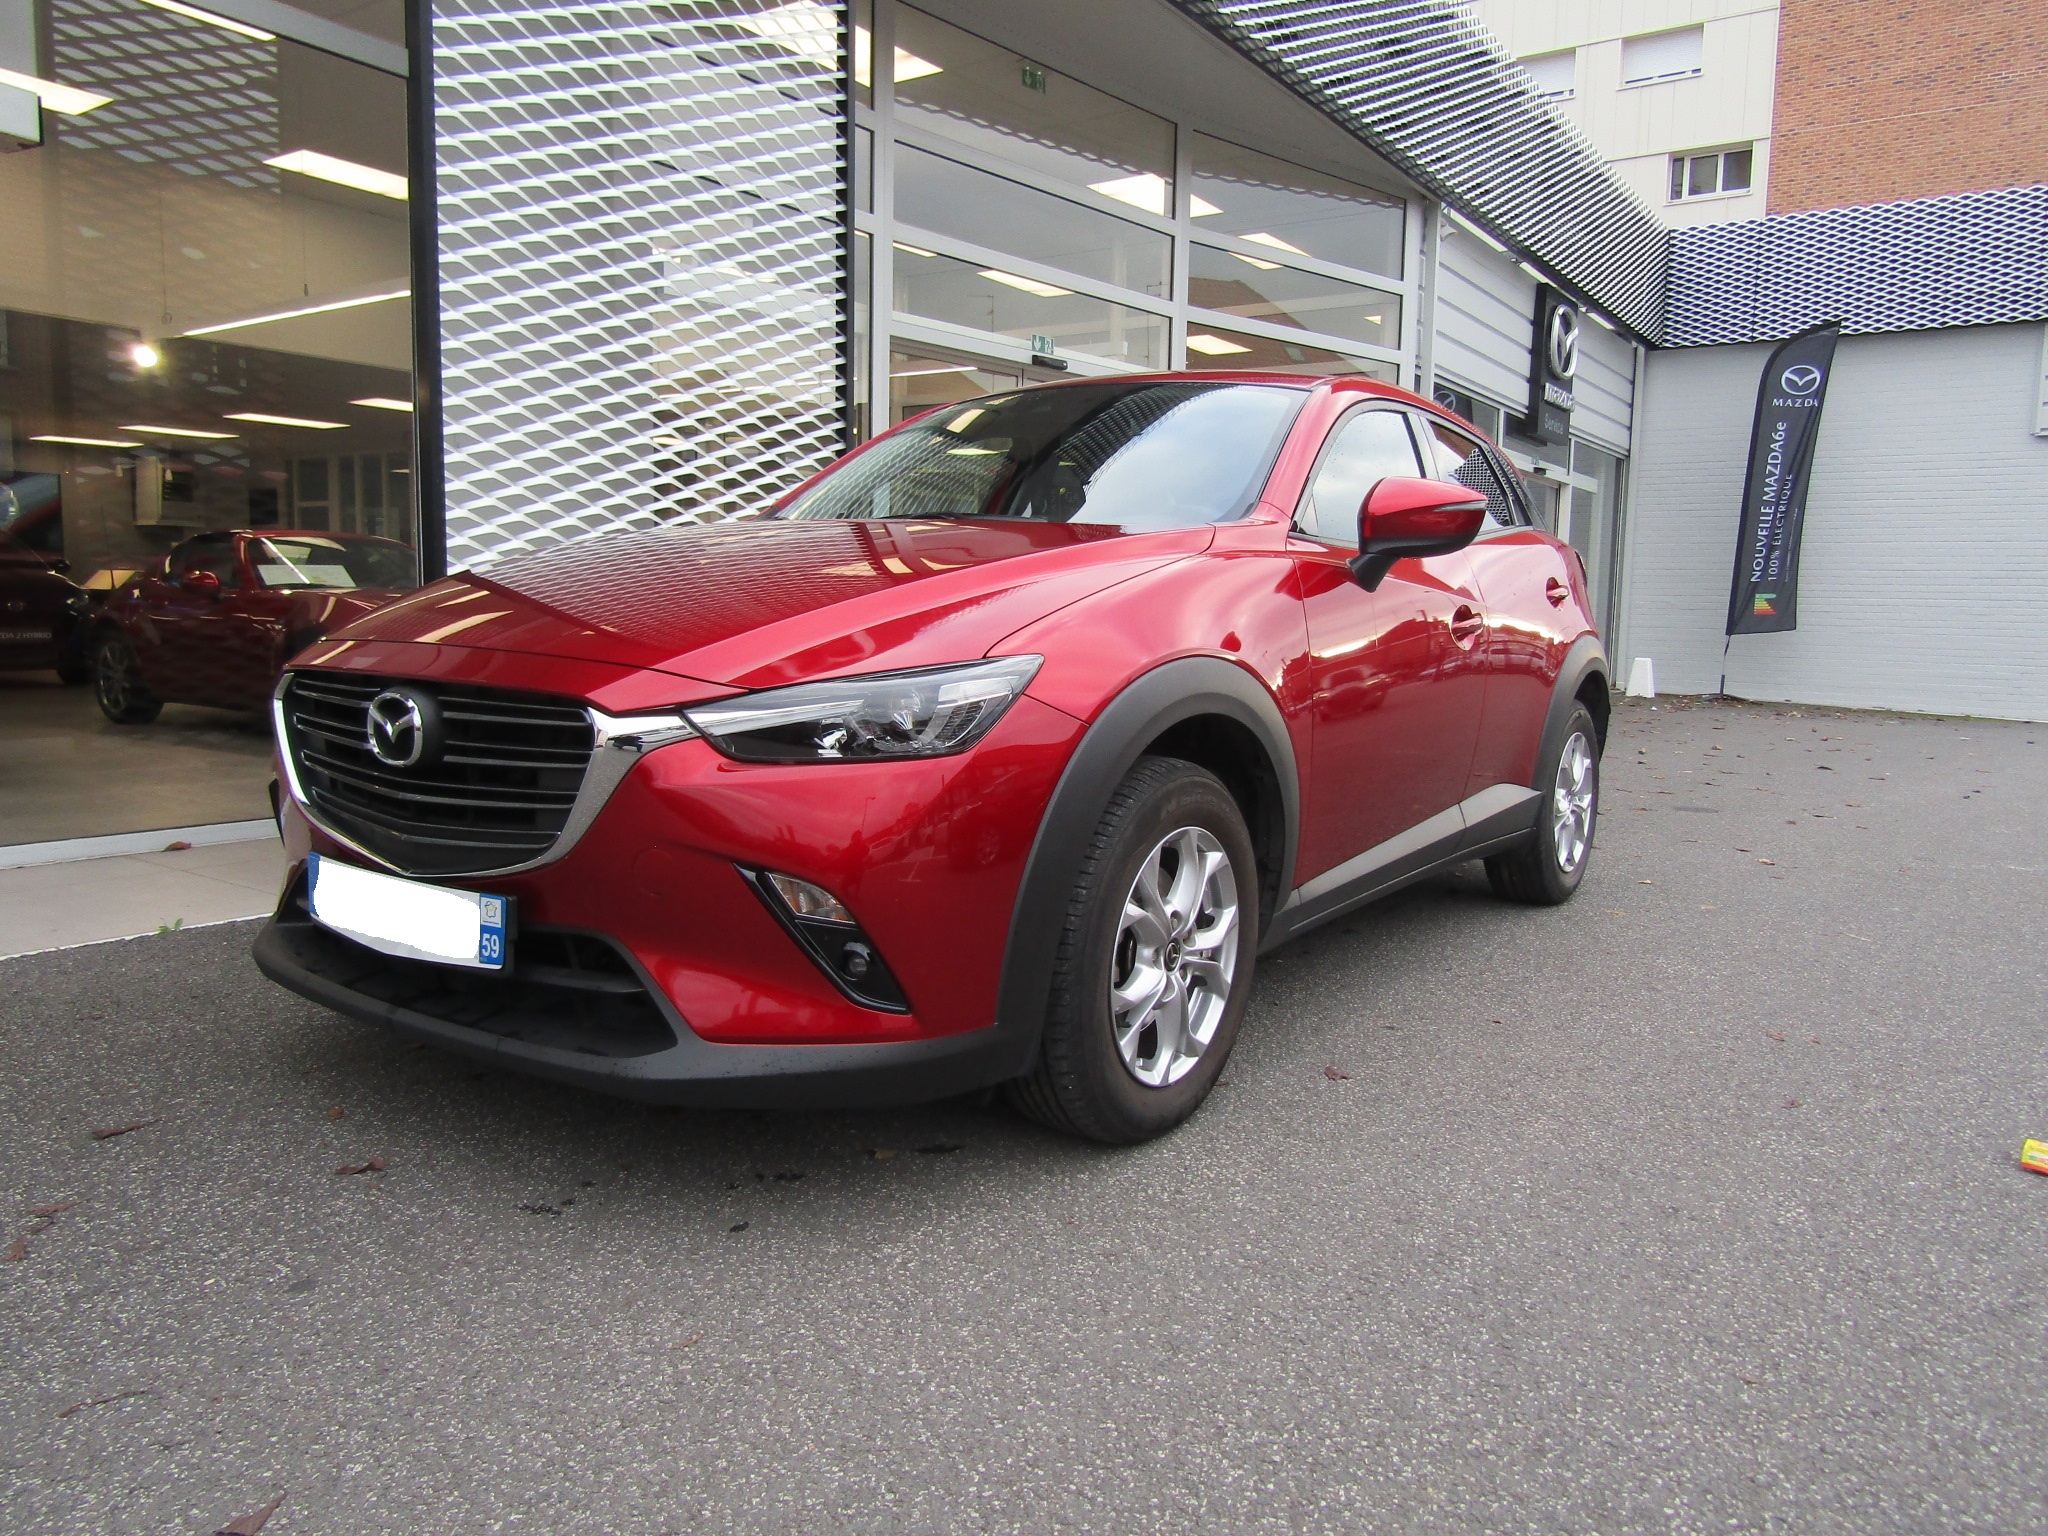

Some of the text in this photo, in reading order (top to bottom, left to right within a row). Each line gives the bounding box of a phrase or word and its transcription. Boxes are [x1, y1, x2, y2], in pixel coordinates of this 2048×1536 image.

[1772, 398, 1818, 408] MAZDA
[1544, 413, 1564, 435] Service
[1750, 421, 1787, 582] NOUVELLE MAZDA6e
[1771, 474, 1792, 545] ÉLECTRIQUE
[1767, 550, 1780, 581] 100%
[482, 933, 499, 958] 59
